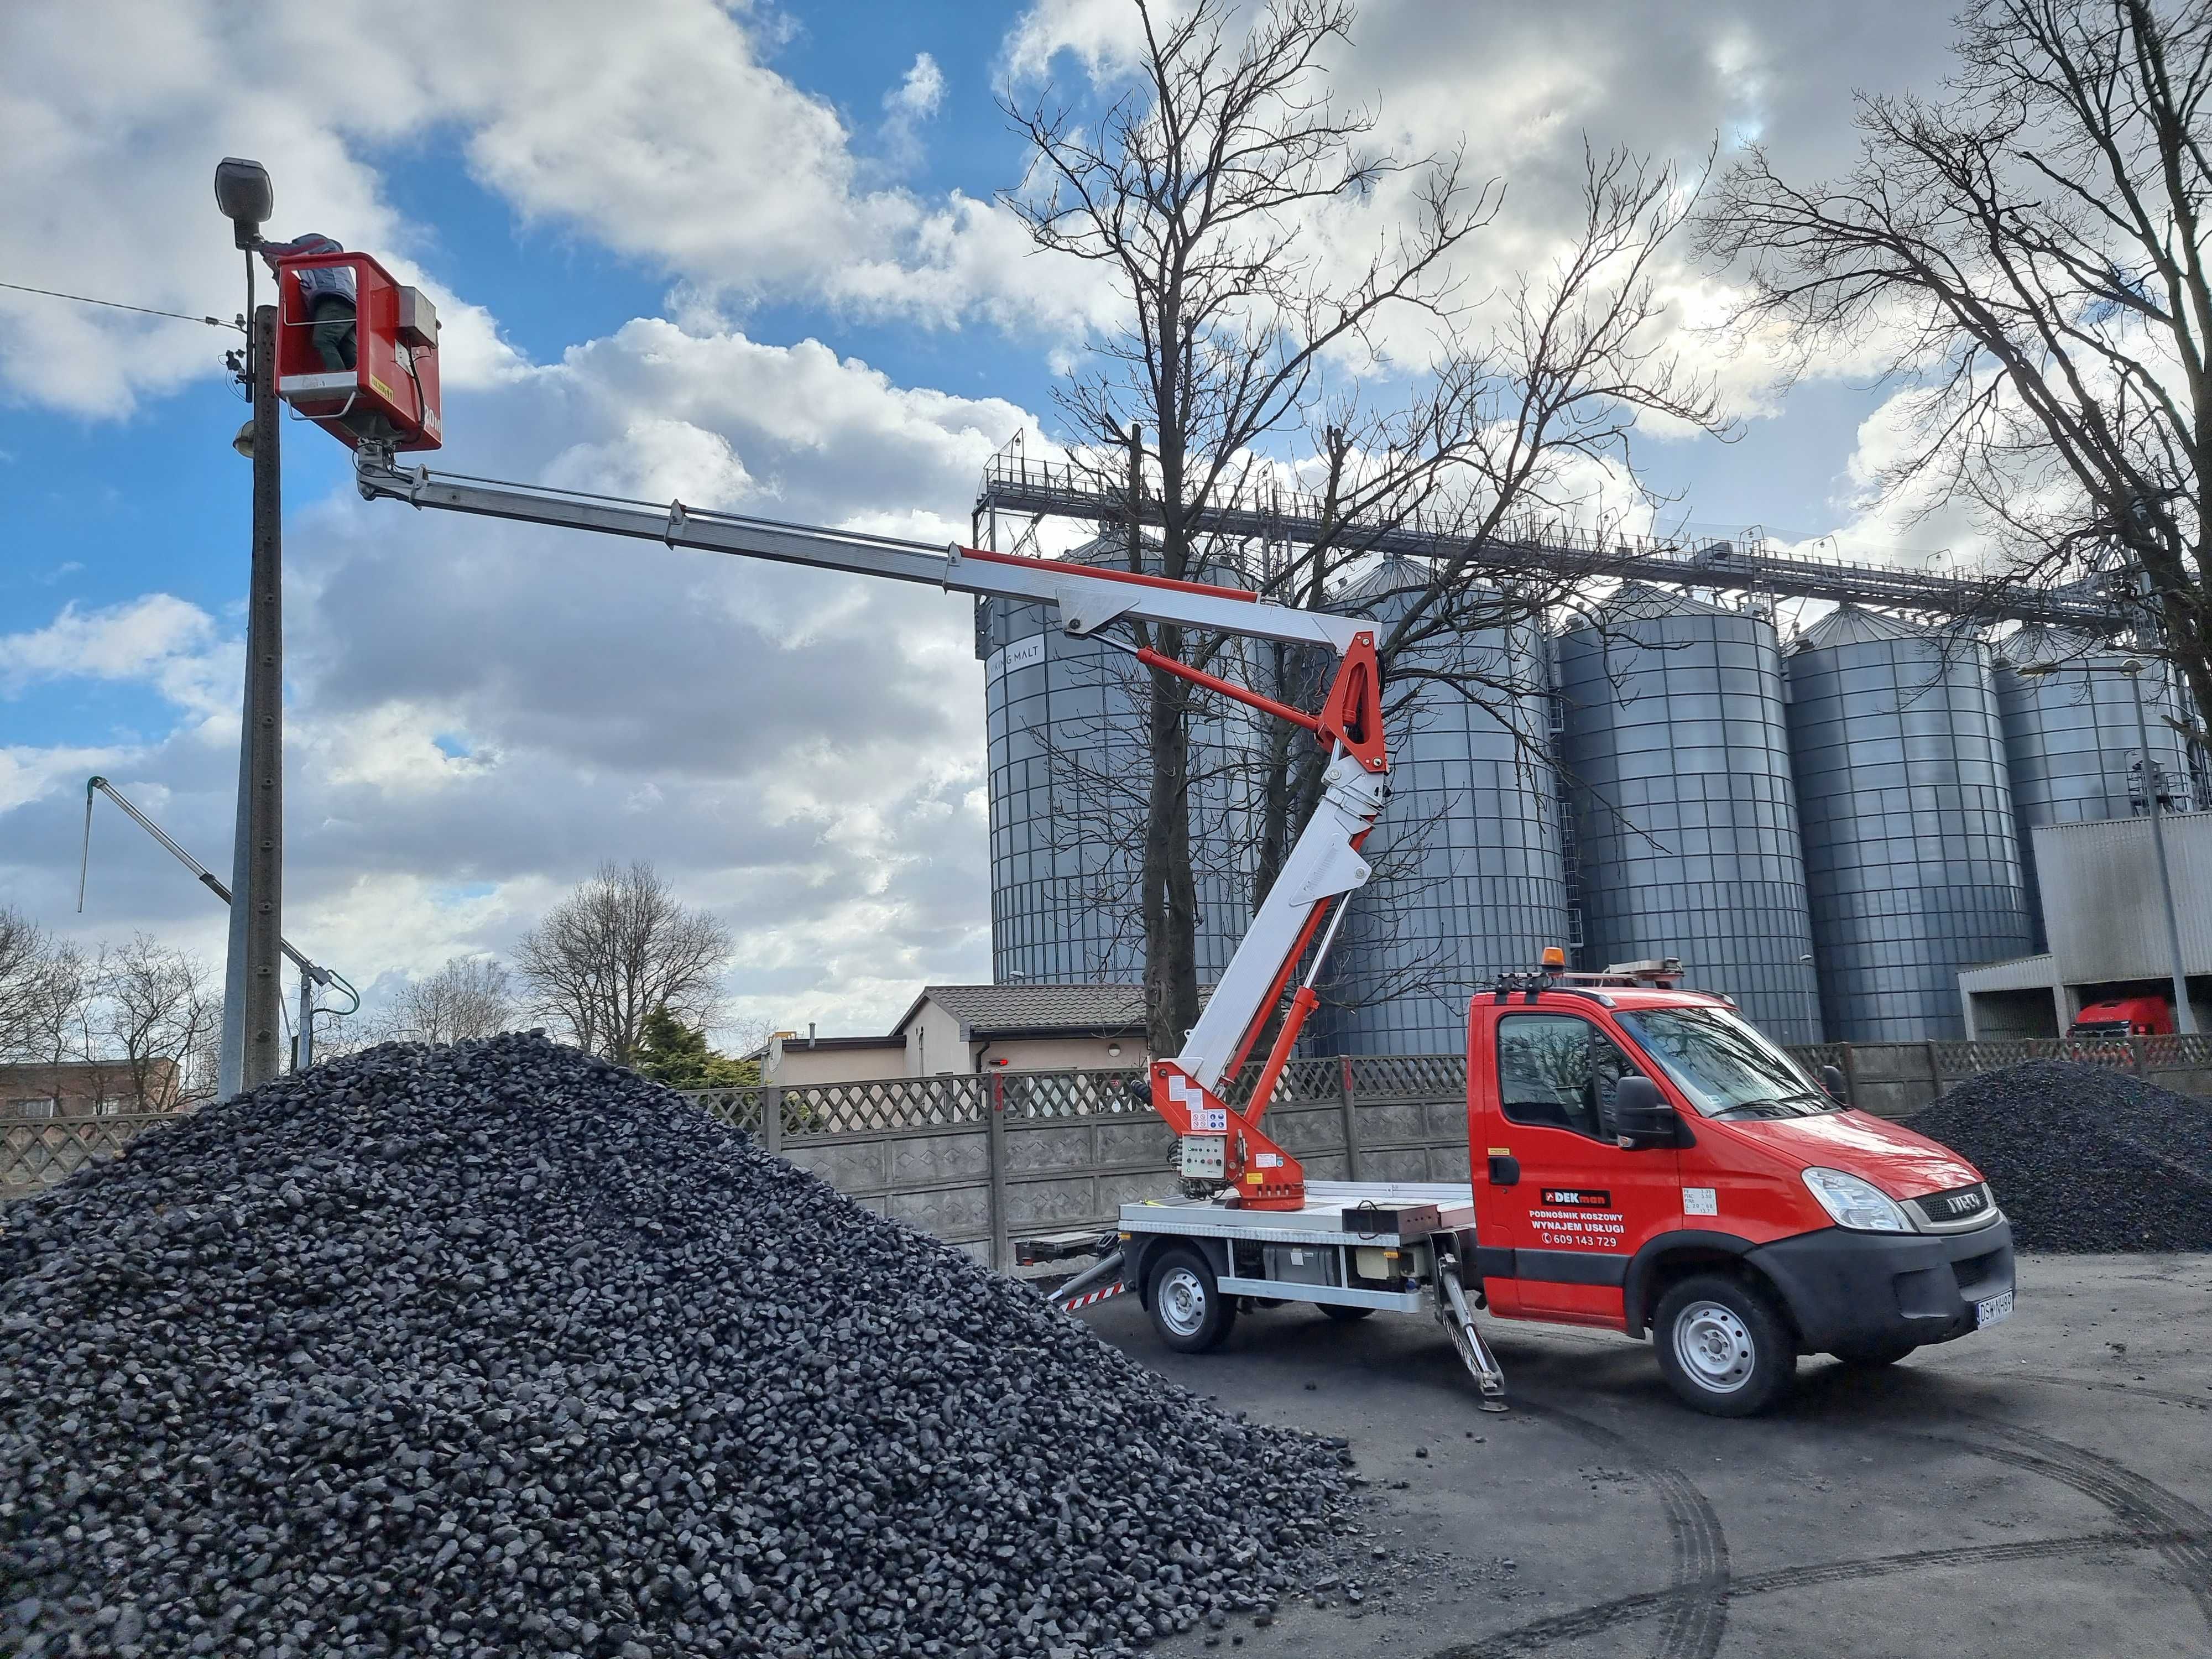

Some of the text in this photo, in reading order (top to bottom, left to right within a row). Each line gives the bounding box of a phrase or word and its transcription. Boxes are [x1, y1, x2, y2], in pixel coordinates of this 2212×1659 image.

[1014, 645, 1038, 662] MALT
[1946, 1193, 1980, 1214] IVECO
[1529, 1210, 1623, 1222] PODNOŚNIK KOSZOWY
[1531, 1220, 1625, 1234] WYNAJEM USŁUGI
[1553, 1234, 1617, 1247] 609 143 729
